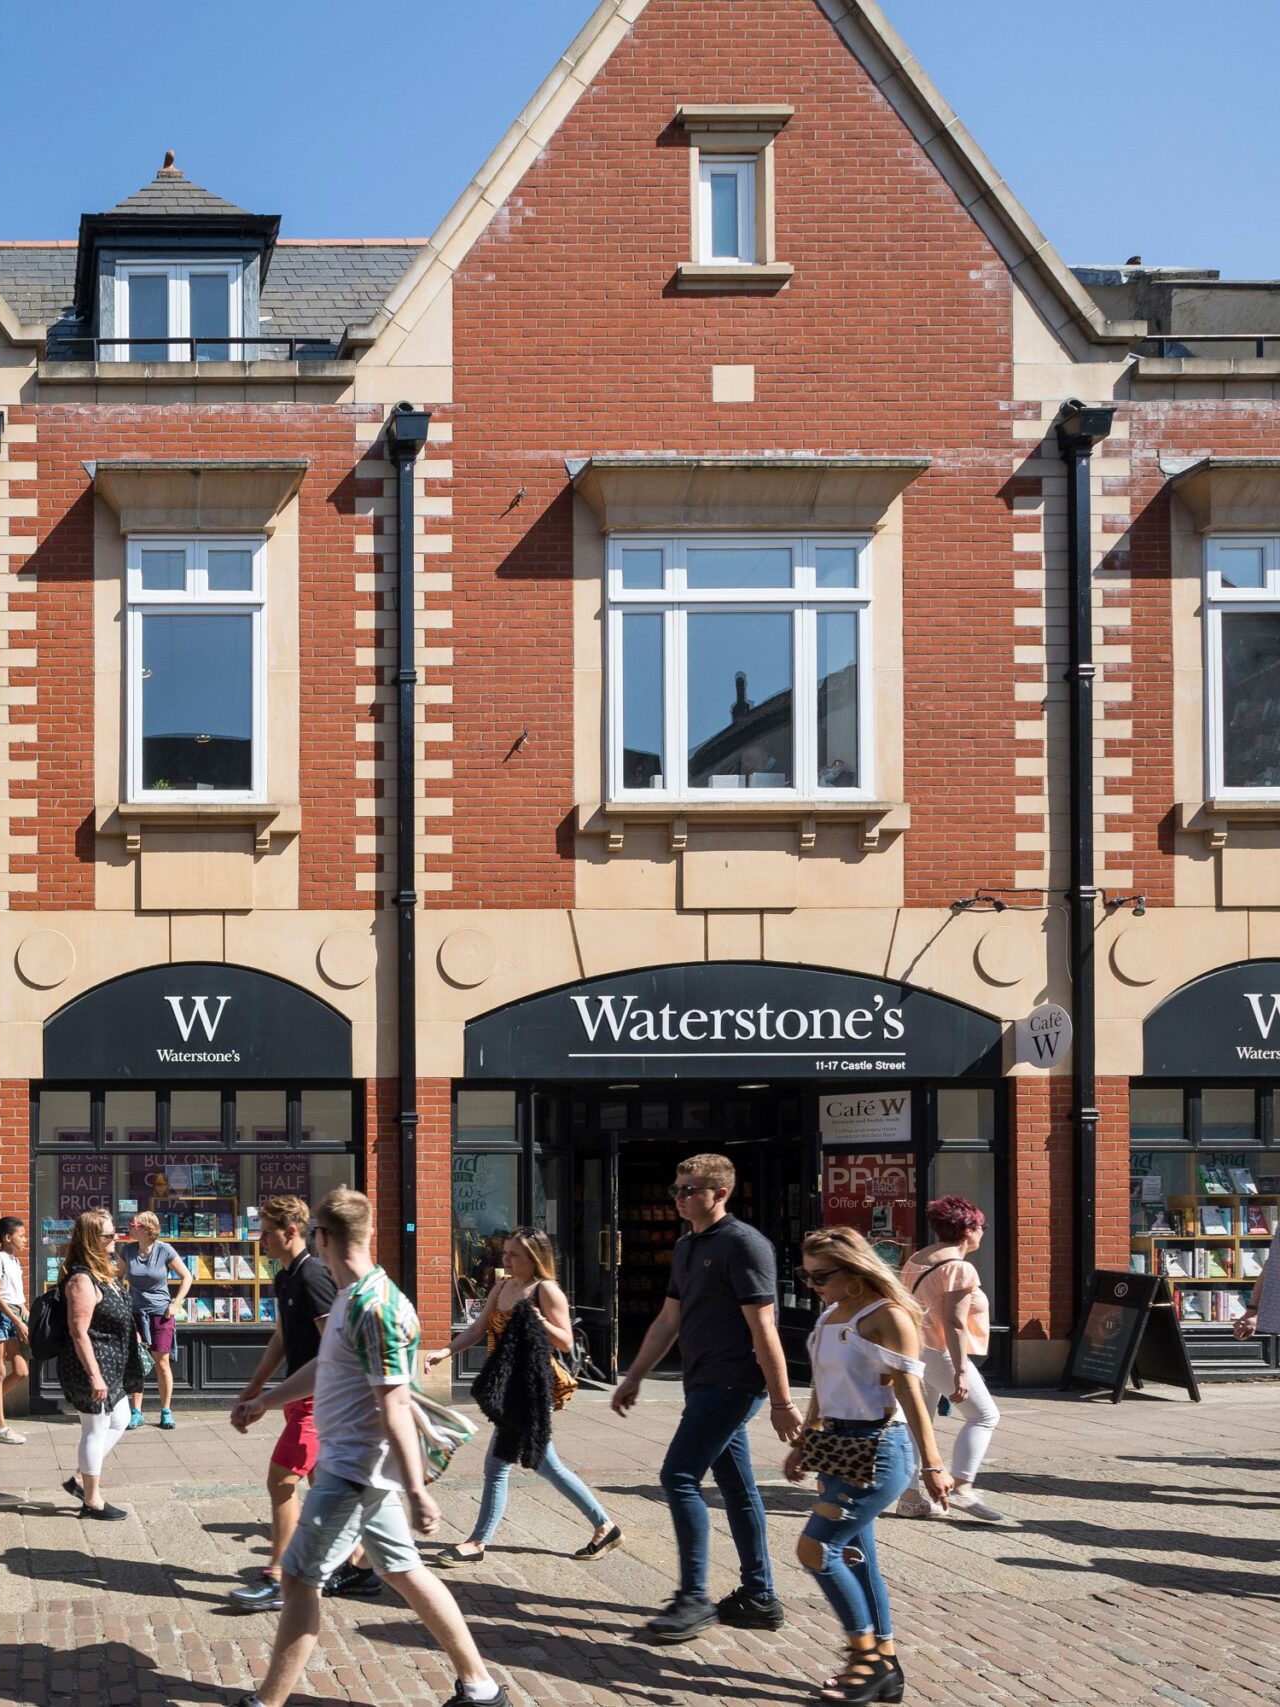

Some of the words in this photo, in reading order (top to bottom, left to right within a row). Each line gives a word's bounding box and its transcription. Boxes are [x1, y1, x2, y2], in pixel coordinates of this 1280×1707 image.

[164, 996, 231, 1042] W
[570, 994, 905, 1042] Waterstone's
[1030, 1012, 1062, 1032] Café
[1032, 1031, 1061, 1061] W
[156, 1048, 240, 1063] Waterstone's
[815, 1060, 838, 1071] 11-17
[841, 1060, 872, 1071] Castle
[875, 1060, 906, 1071] Street
[826, 1099, 876, 1118] Café
[879, 1097, 907, 1116] W
[62, 1163, 82, 1173] GET
[85, 1163, 109, 1173] ONE
[260, 1162, 280, 1172] GET
[283, 1162, 306, 1172] ONE
[63, 1176, 107, 1191] HALF
[260, 1175, 305, 1190] HALF
[871, 1178, 900, 1186] HALF
[60, 1194, 110, 1210] PRICE
[828, 1196, 859, 1208] Offer
